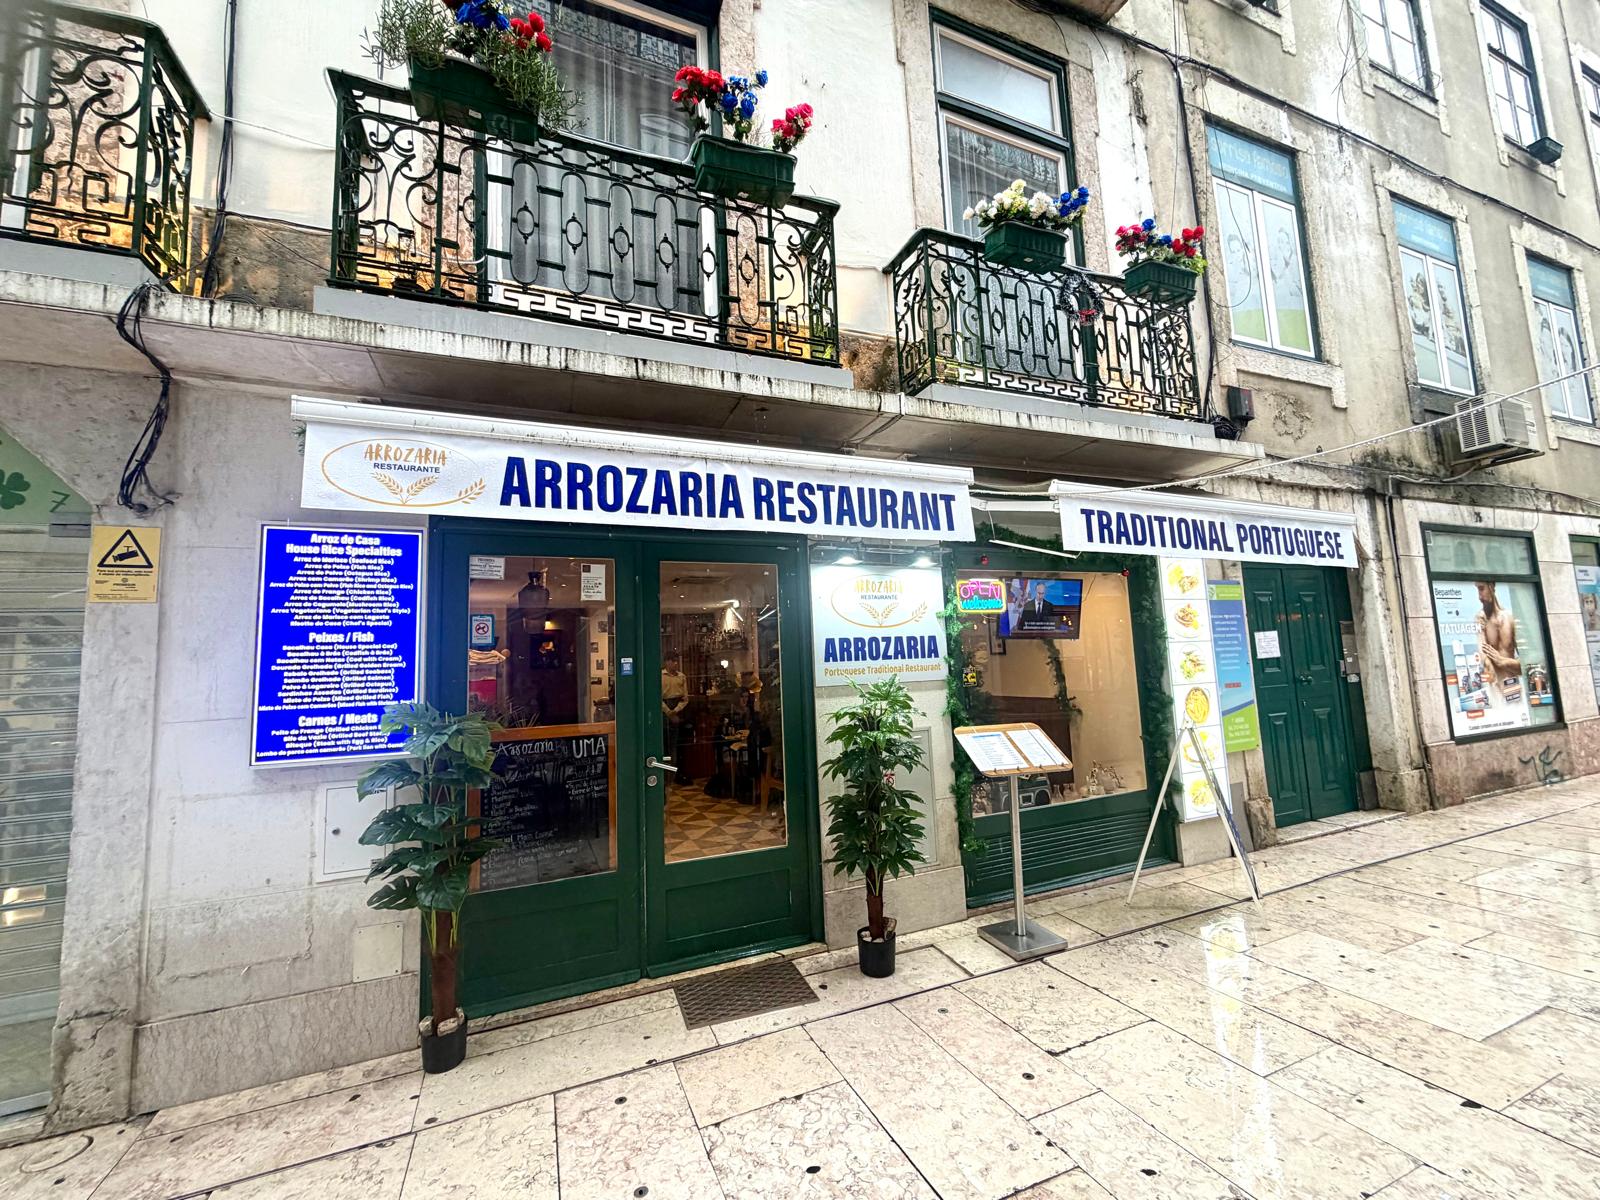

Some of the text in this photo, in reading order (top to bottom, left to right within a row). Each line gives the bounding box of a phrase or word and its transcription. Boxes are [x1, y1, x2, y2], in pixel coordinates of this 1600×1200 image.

[364, 443, 448, 466] ARROZARIA
[374, 462, 440, 474] RESTAURANTE
[500, 456, 955, 531] ARROZARIA RESTAURANT
[49, 490, 71, 513] 7
[310, 533, 340, 544] Arroz
[355, 535, 380, 545] Casa
[1080, 508, 1344, 560] TRADITIONAL PORTUGUESE
[286, 544, 402, 557] House Rice Specialties
[854, 580, 904, 593] ARROZARIA
[960, 580, 1000, 598] OPEN
[1435, 588, 1462, 596] Bepanthen
[1440, 623, 1482, 634] TATUAGEM
[309, 632, 374, 643] Peixes / Fish
[824, 635, 940, 662] ARROZARIA
[824, 664, 941, 676] Portuguese Traditional Restaurant
[298, 713, 378, 727] Carnes / Meats
[572, 737, 606, 758] UMA
